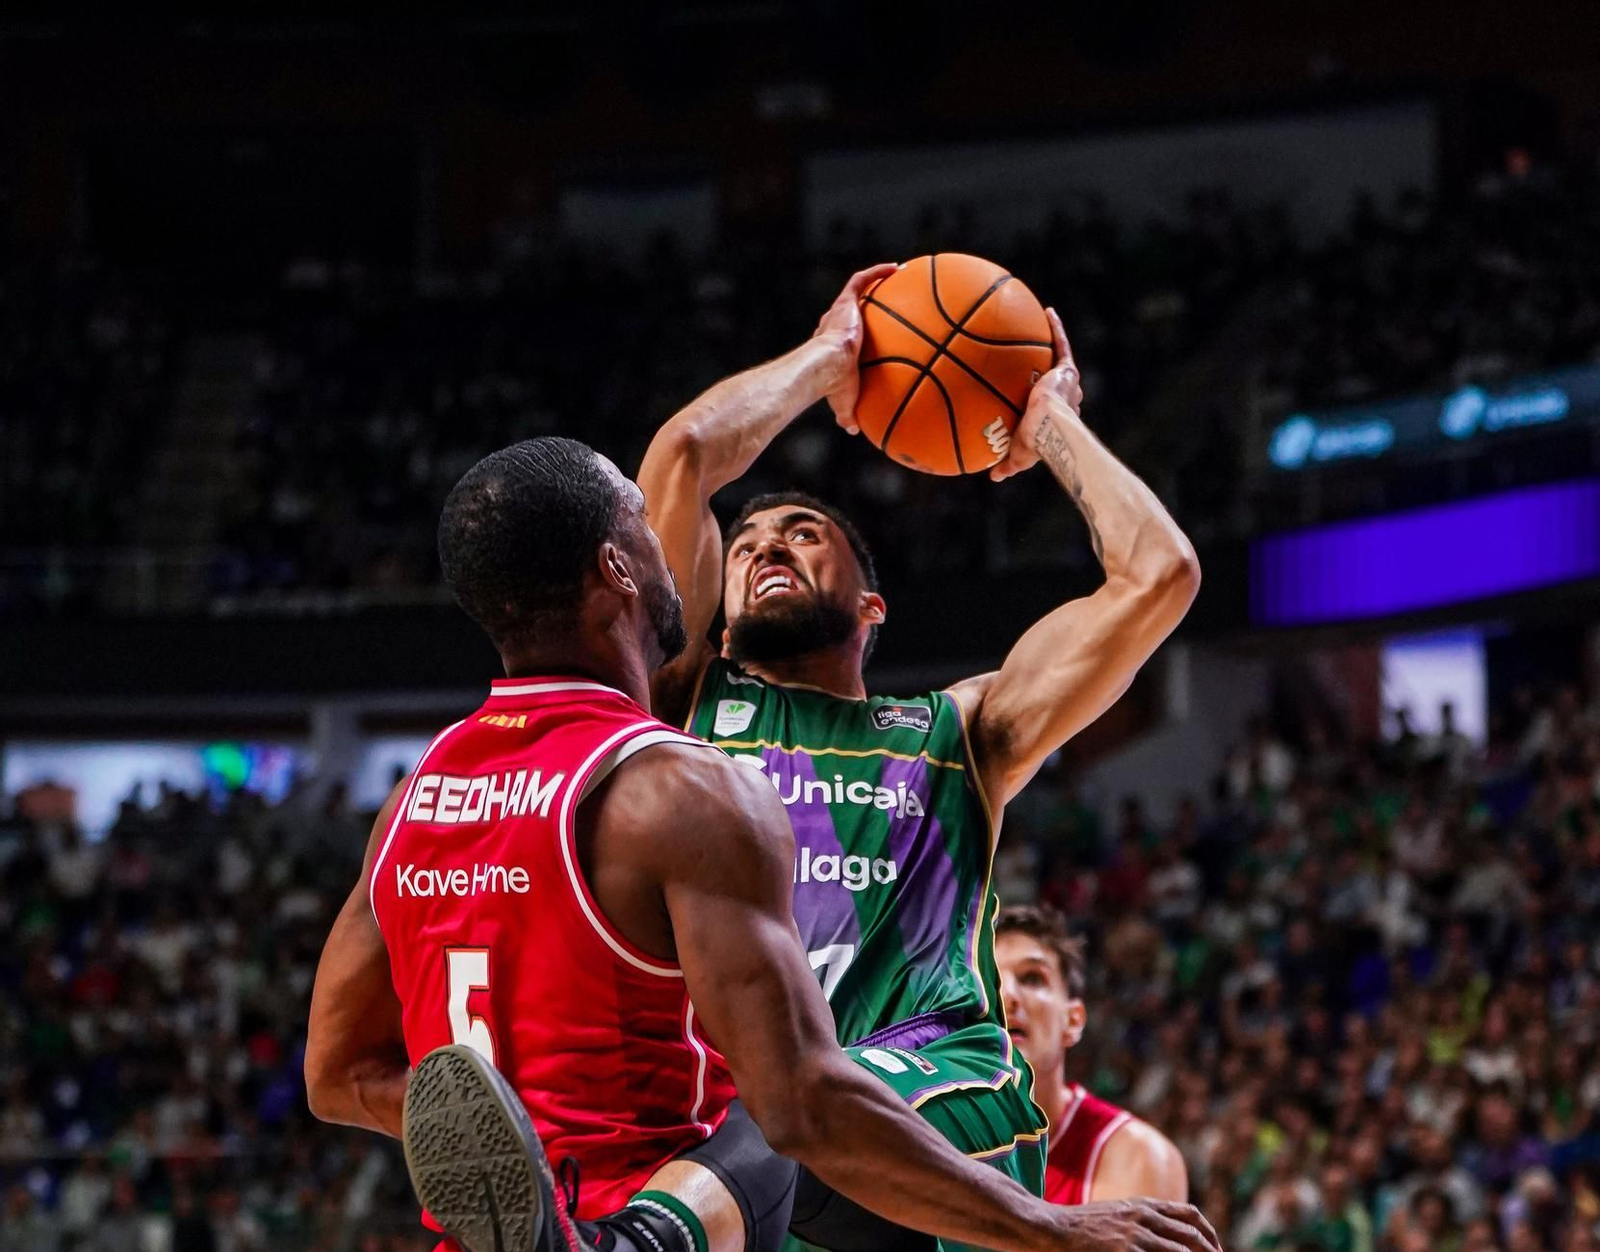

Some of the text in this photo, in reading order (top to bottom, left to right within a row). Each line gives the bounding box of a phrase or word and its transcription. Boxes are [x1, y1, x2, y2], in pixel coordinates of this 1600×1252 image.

[772, 773, 925, 820] Unicaja
[794, 847, 898, 891] laga
[446, 948, 498, 1067] 5
